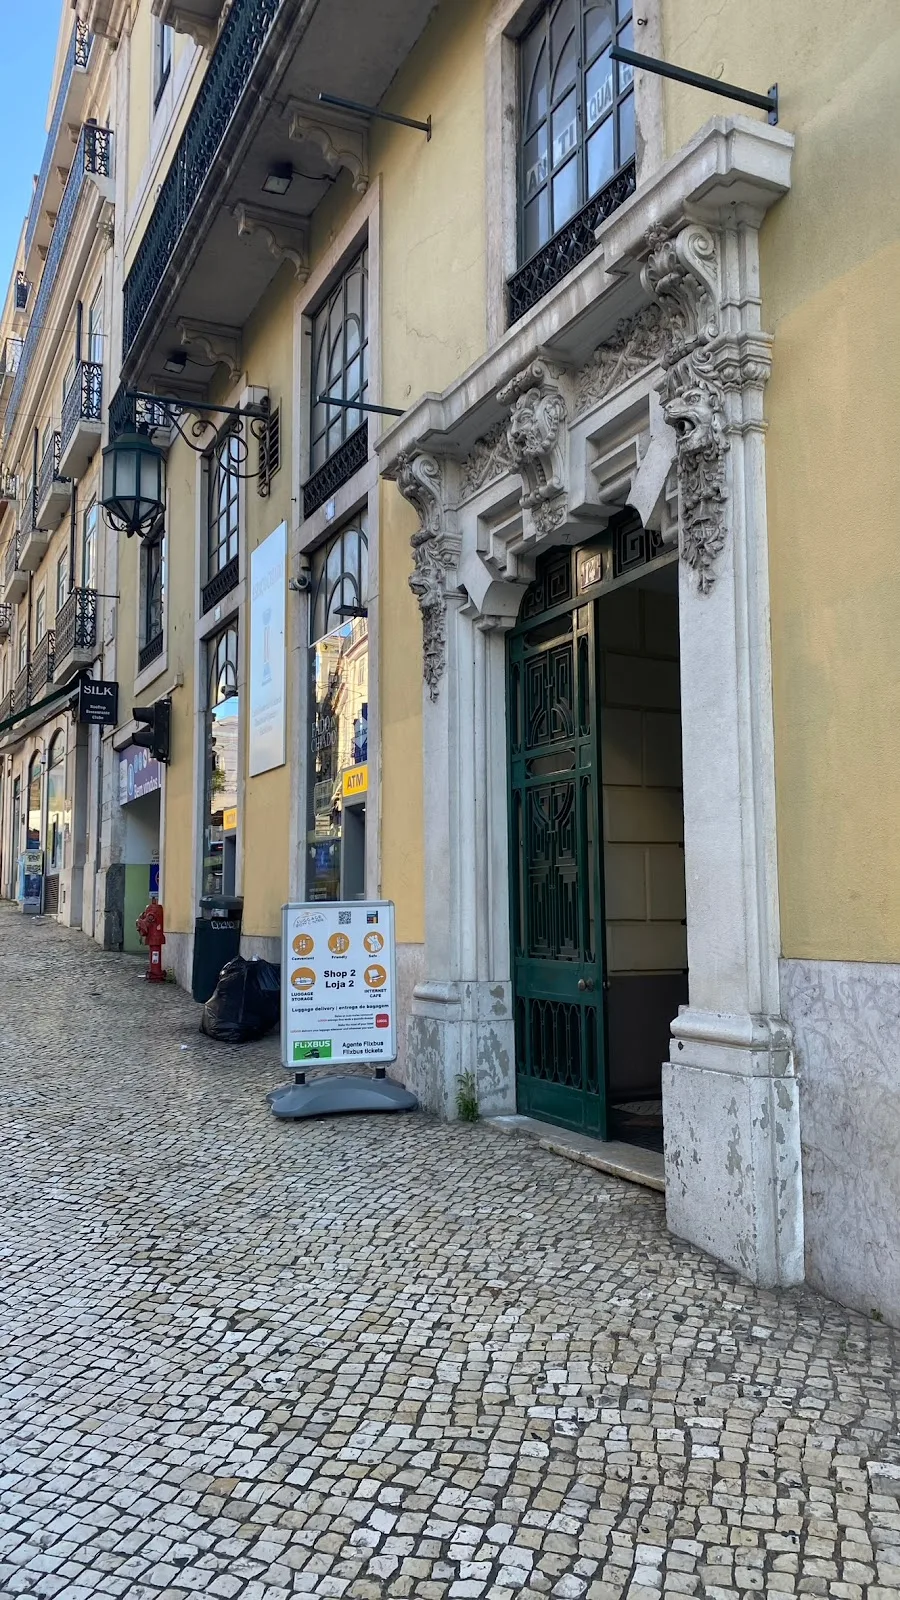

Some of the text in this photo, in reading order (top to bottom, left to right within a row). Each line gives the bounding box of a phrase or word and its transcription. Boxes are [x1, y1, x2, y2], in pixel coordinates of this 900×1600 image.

[84, 685, 114, 696] SILK
[311, 730, 337, 752] CHIADO
[347, 772, 364, 790] ATM
[323, 969, 356, 979] Shop 2
[325, 980, 355, 990] Loja 2
